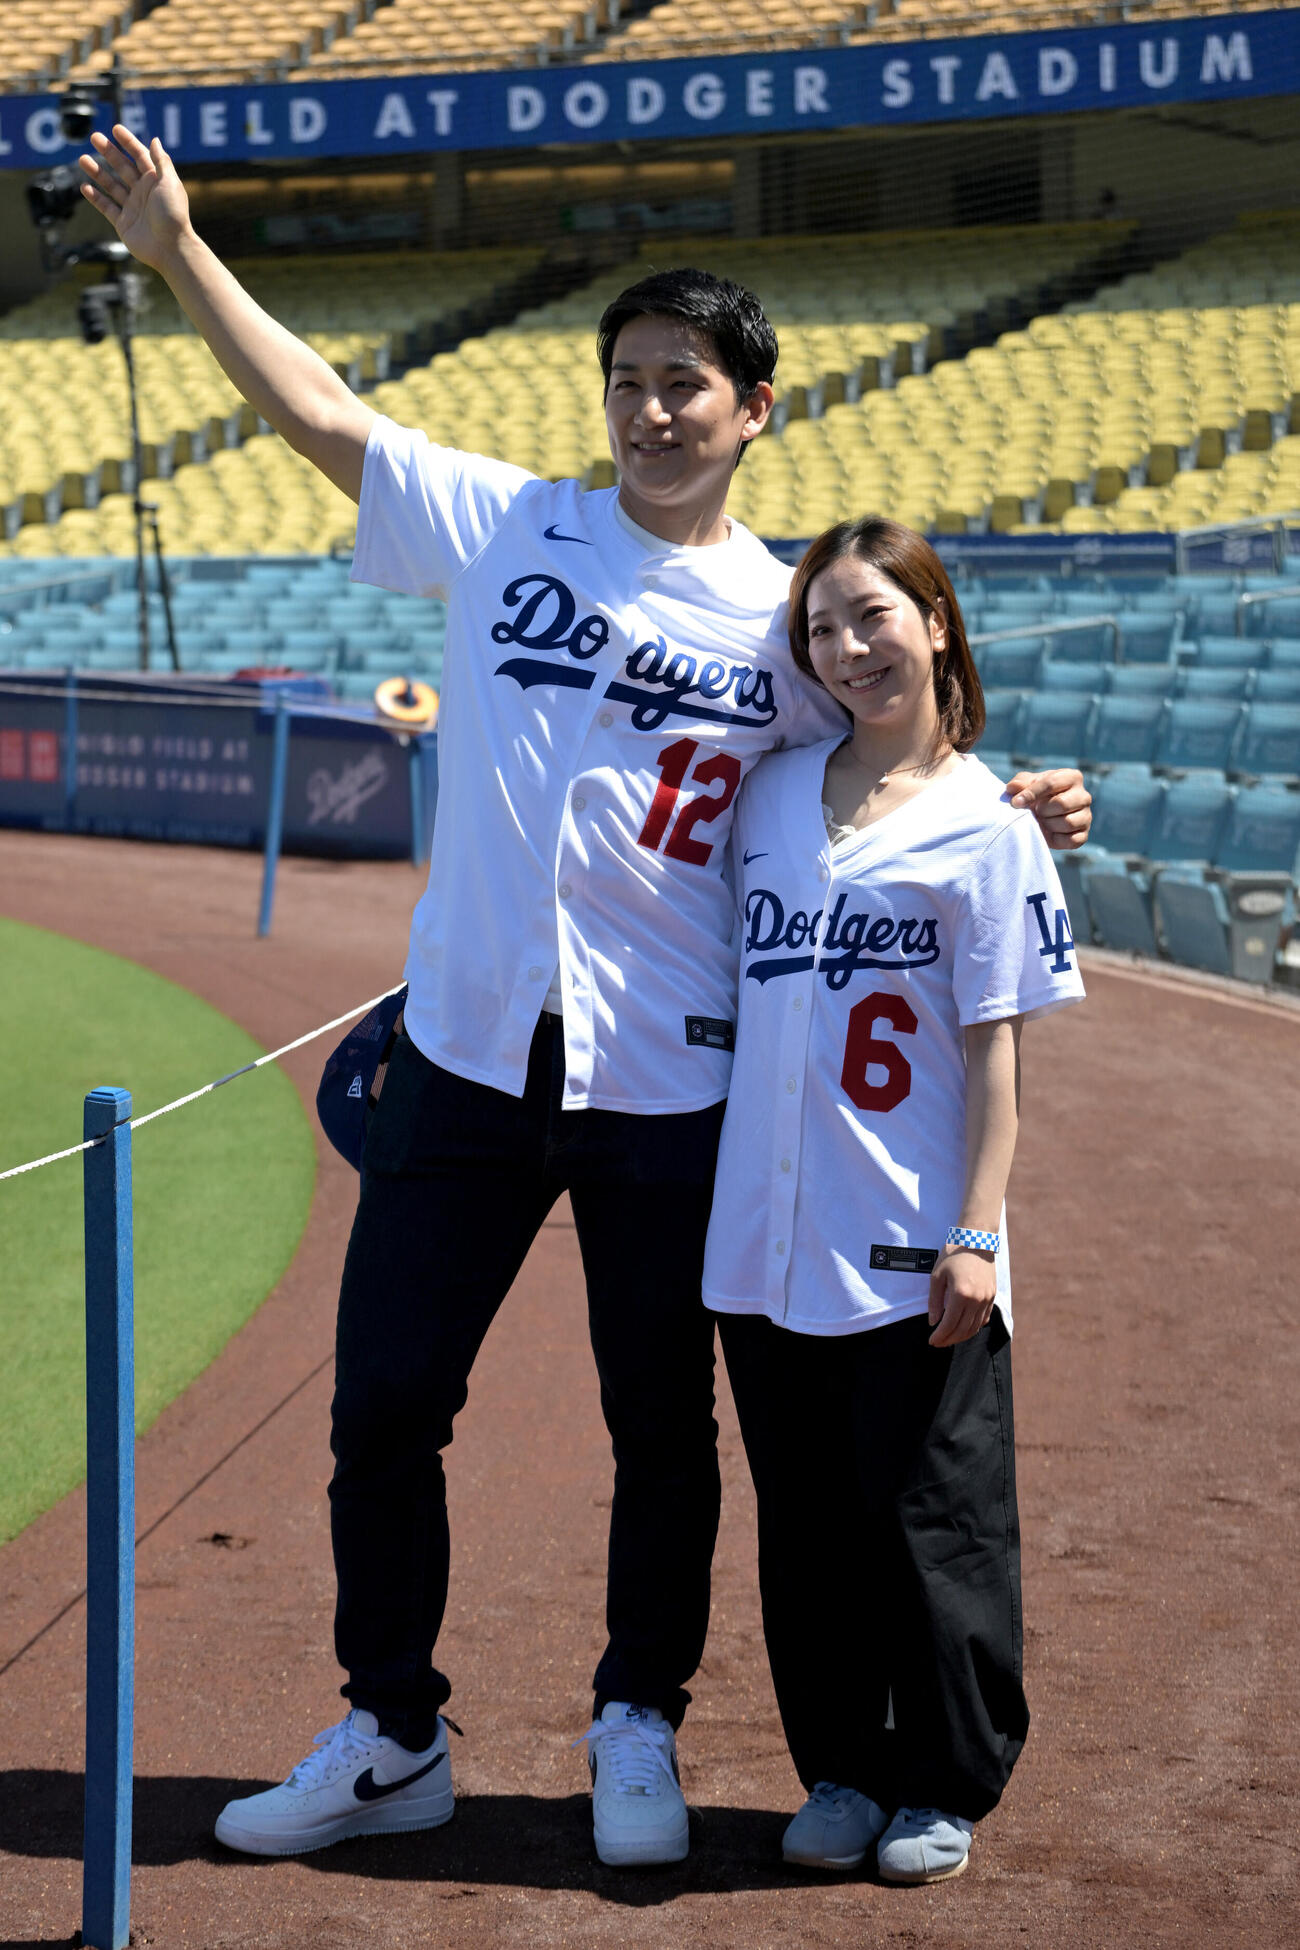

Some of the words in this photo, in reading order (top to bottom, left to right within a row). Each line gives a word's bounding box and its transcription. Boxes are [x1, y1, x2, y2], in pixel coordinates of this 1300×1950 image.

[121, 98, 326, 148] FIELD
[376, 91, 458, 138] AT
[507, 66, 831, 132] DODGER
[881, 32, 1253, 108] STADIUM
[491, 574, 777, 731] Dodgers
[636, 737, 741, 867] 12
[745, 889, 940, 991] Dodgers
[1026, 891, 1074, 974] LA
[840, 991, 918, 1113] 6
